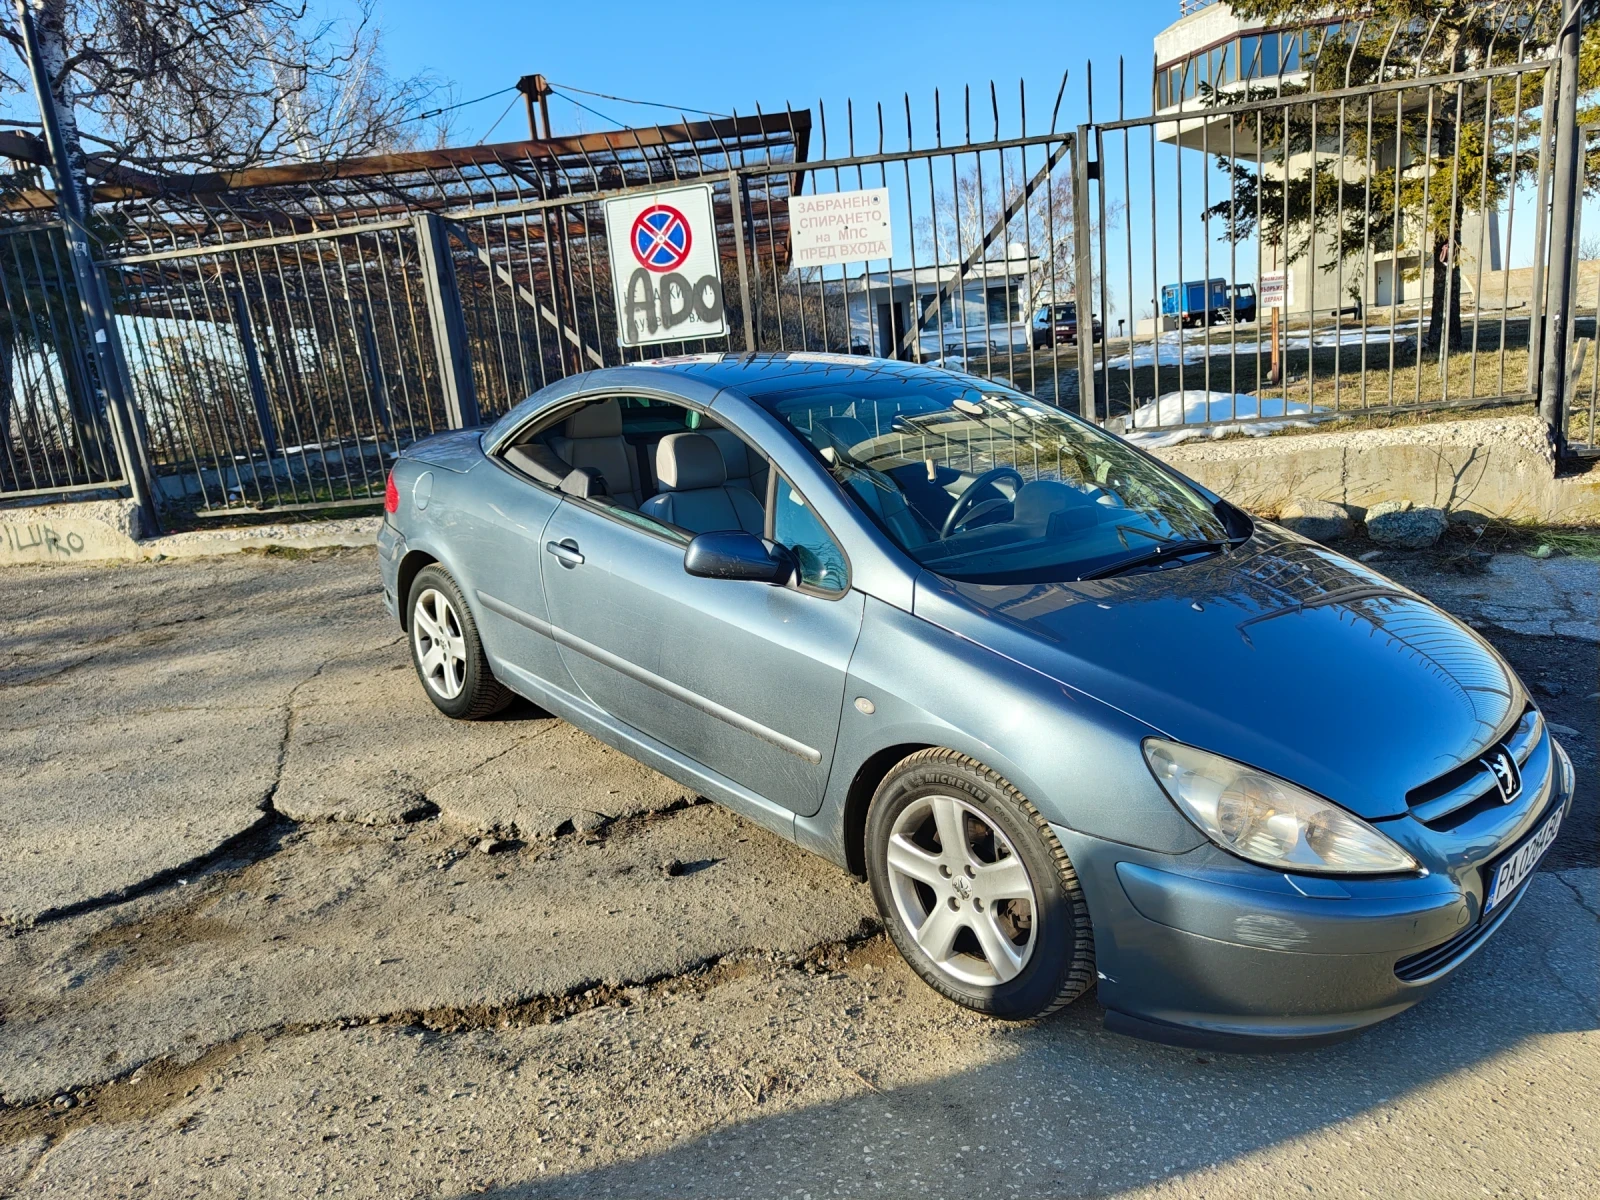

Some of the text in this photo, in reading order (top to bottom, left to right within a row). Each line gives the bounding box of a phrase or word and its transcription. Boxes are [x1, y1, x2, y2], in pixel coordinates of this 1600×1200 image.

[798, 194, 880, 213] ЗАБРАНЕН
[799, 210, 882, 229] СПИРАНЕТО
[816, 227, 868, 243] на МПС
[800, 241, 887, 260] ПРЕД ВХОДА
[624, 267, 724, 345] ADO
[925, 773, 987, 801] MICHELIN
[925, 974, 985, 1010] MICHELIN
